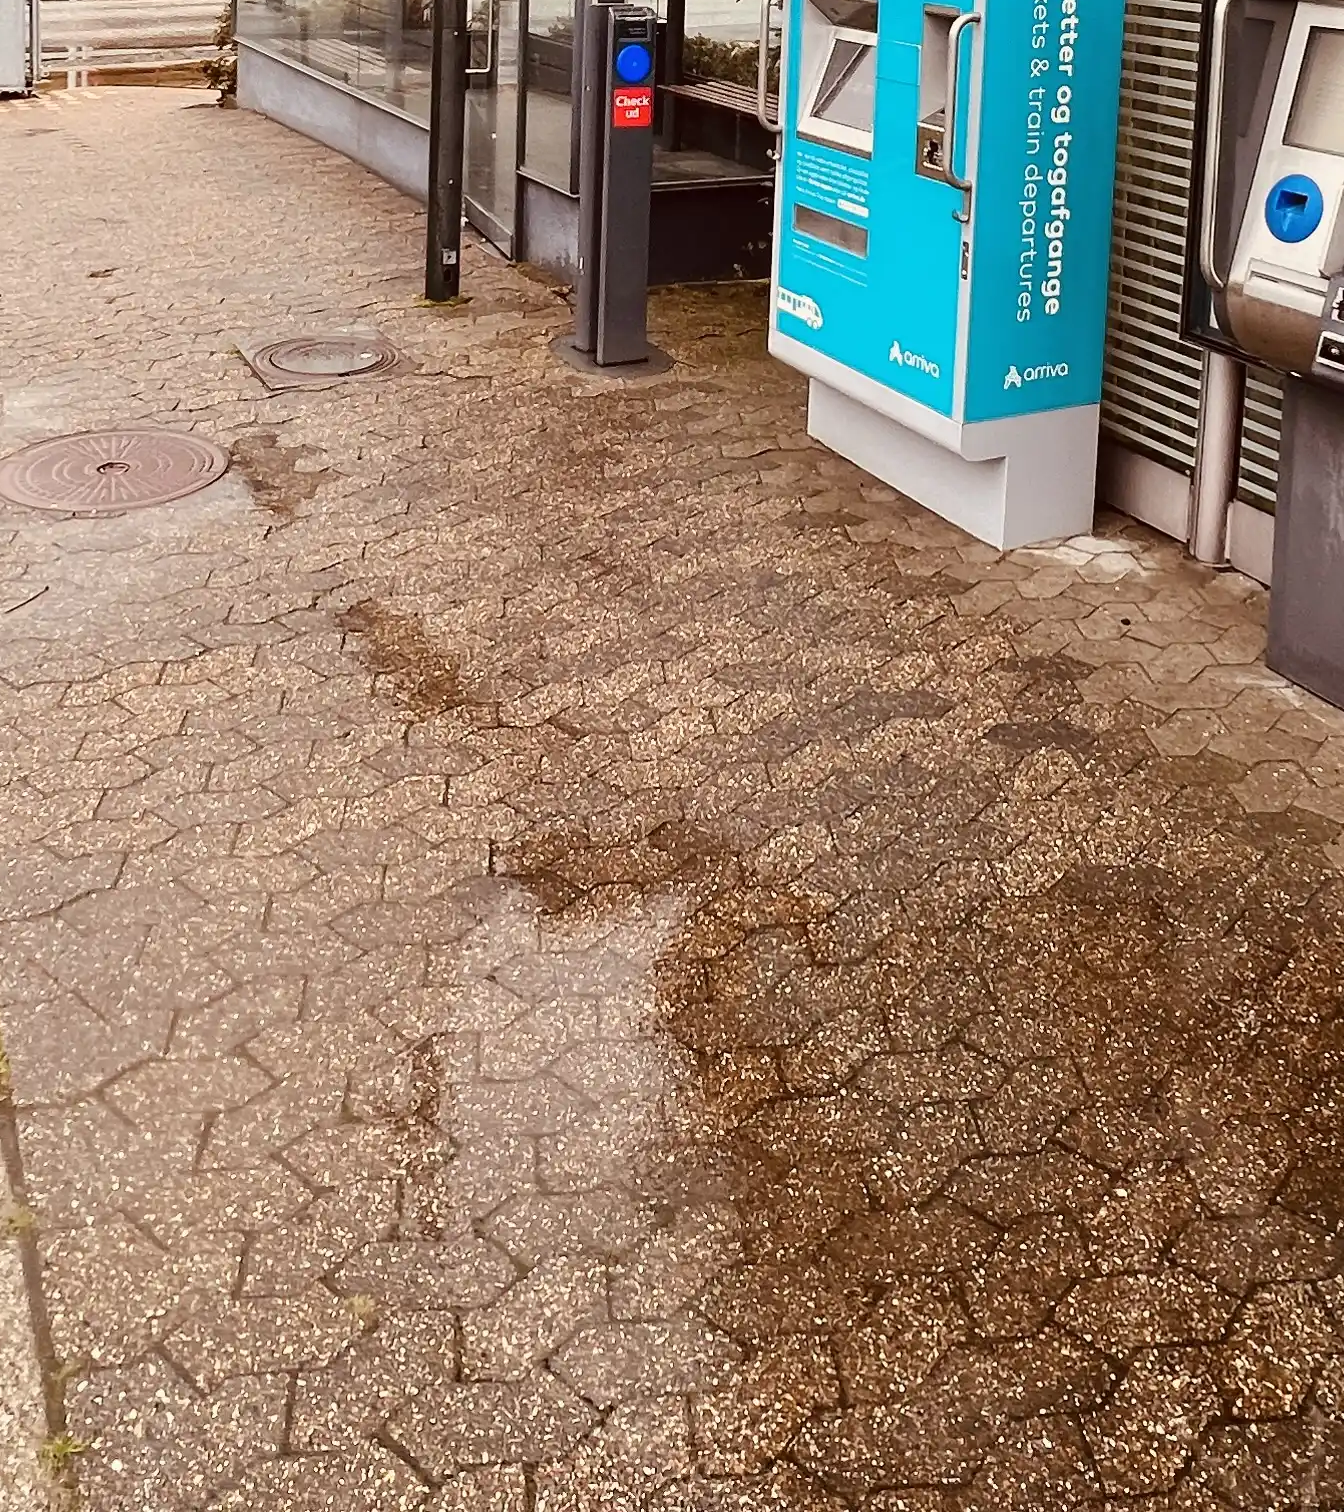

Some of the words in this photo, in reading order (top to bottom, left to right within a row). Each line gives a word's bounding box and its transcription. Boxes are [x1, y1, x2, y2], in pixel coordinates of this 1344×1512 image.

[1030, 58, 1050, 78] &
[616, 94, 650, 108] Check
[625, 107, 640, 119] ud
[1050, 85, 1072, 124] og
[1025, 86, 1046, 156] train
[1041, 131, 1073, 315] togafgange
[1016, 163, 1044, 323] departures
[903, 350, 940, 379] arriva
[1023, 361, 1069, 382] arriva
